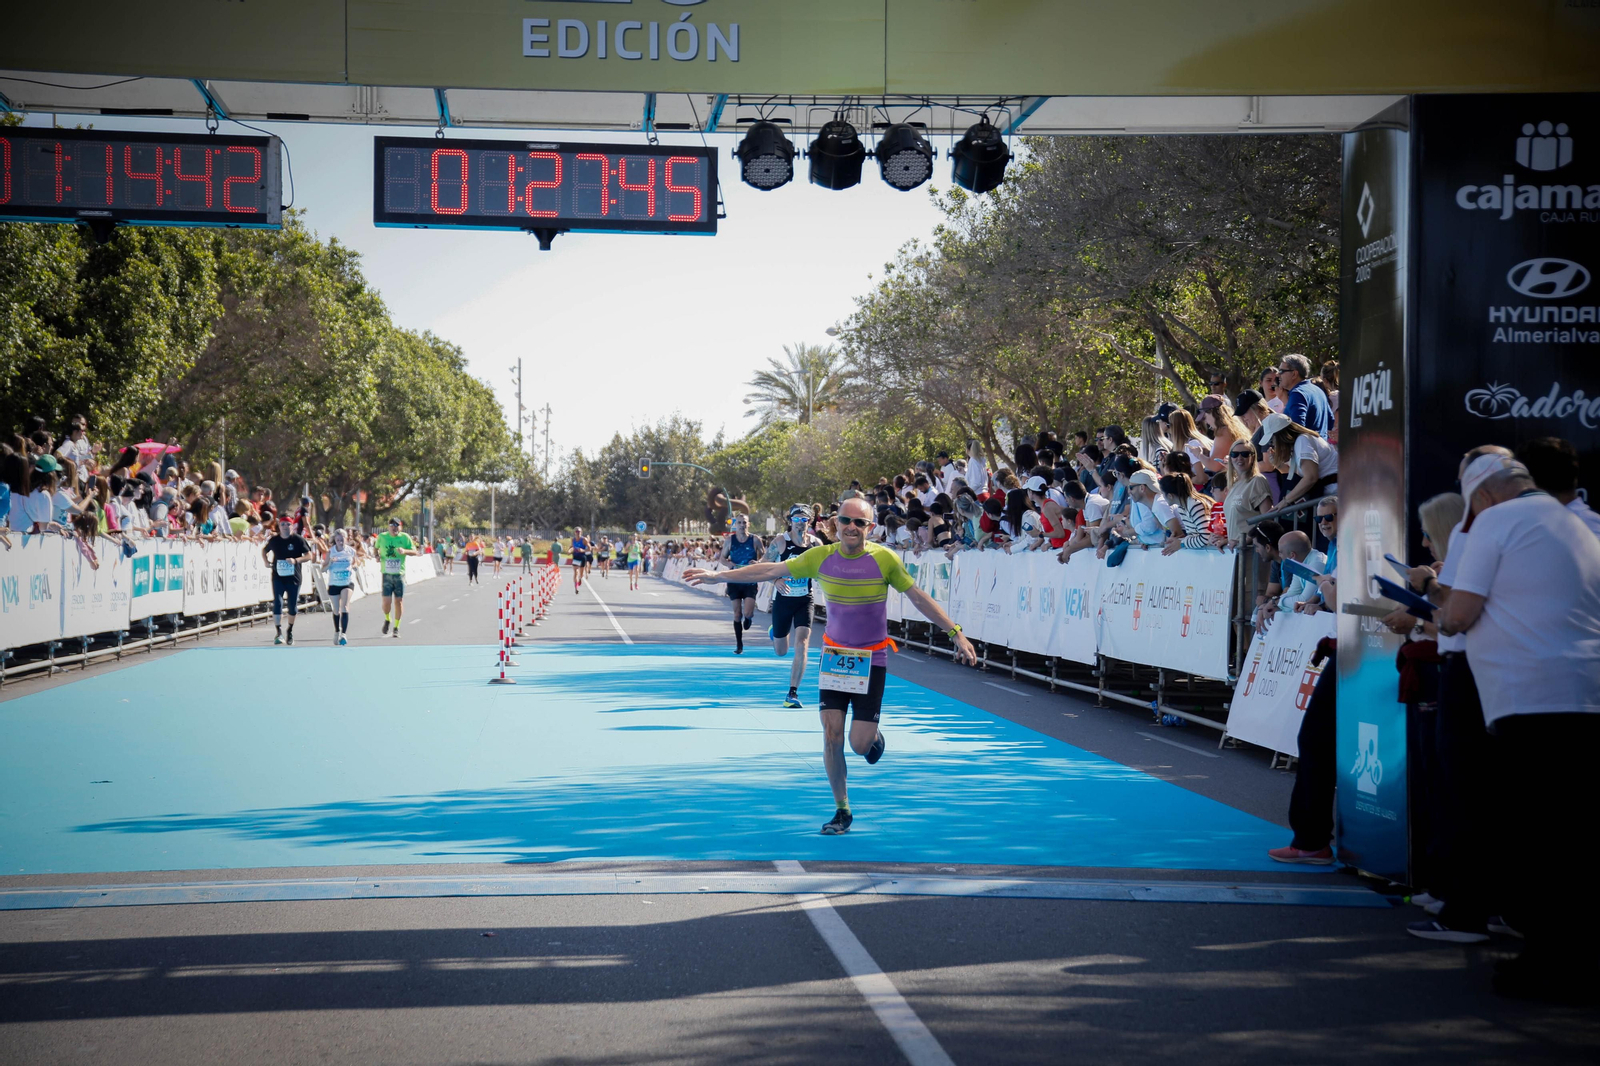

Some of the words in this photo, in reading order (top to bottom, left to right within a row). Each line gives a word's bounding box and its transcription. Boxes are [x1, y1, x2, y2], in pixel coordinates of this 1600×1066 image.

[522, 12, 740, 62] EDICIÓN
[431, 148, 702, 222] 01:27:45
[1540, 211, 1575, 223] CAJA
[836, 656, 856, 670] 45
